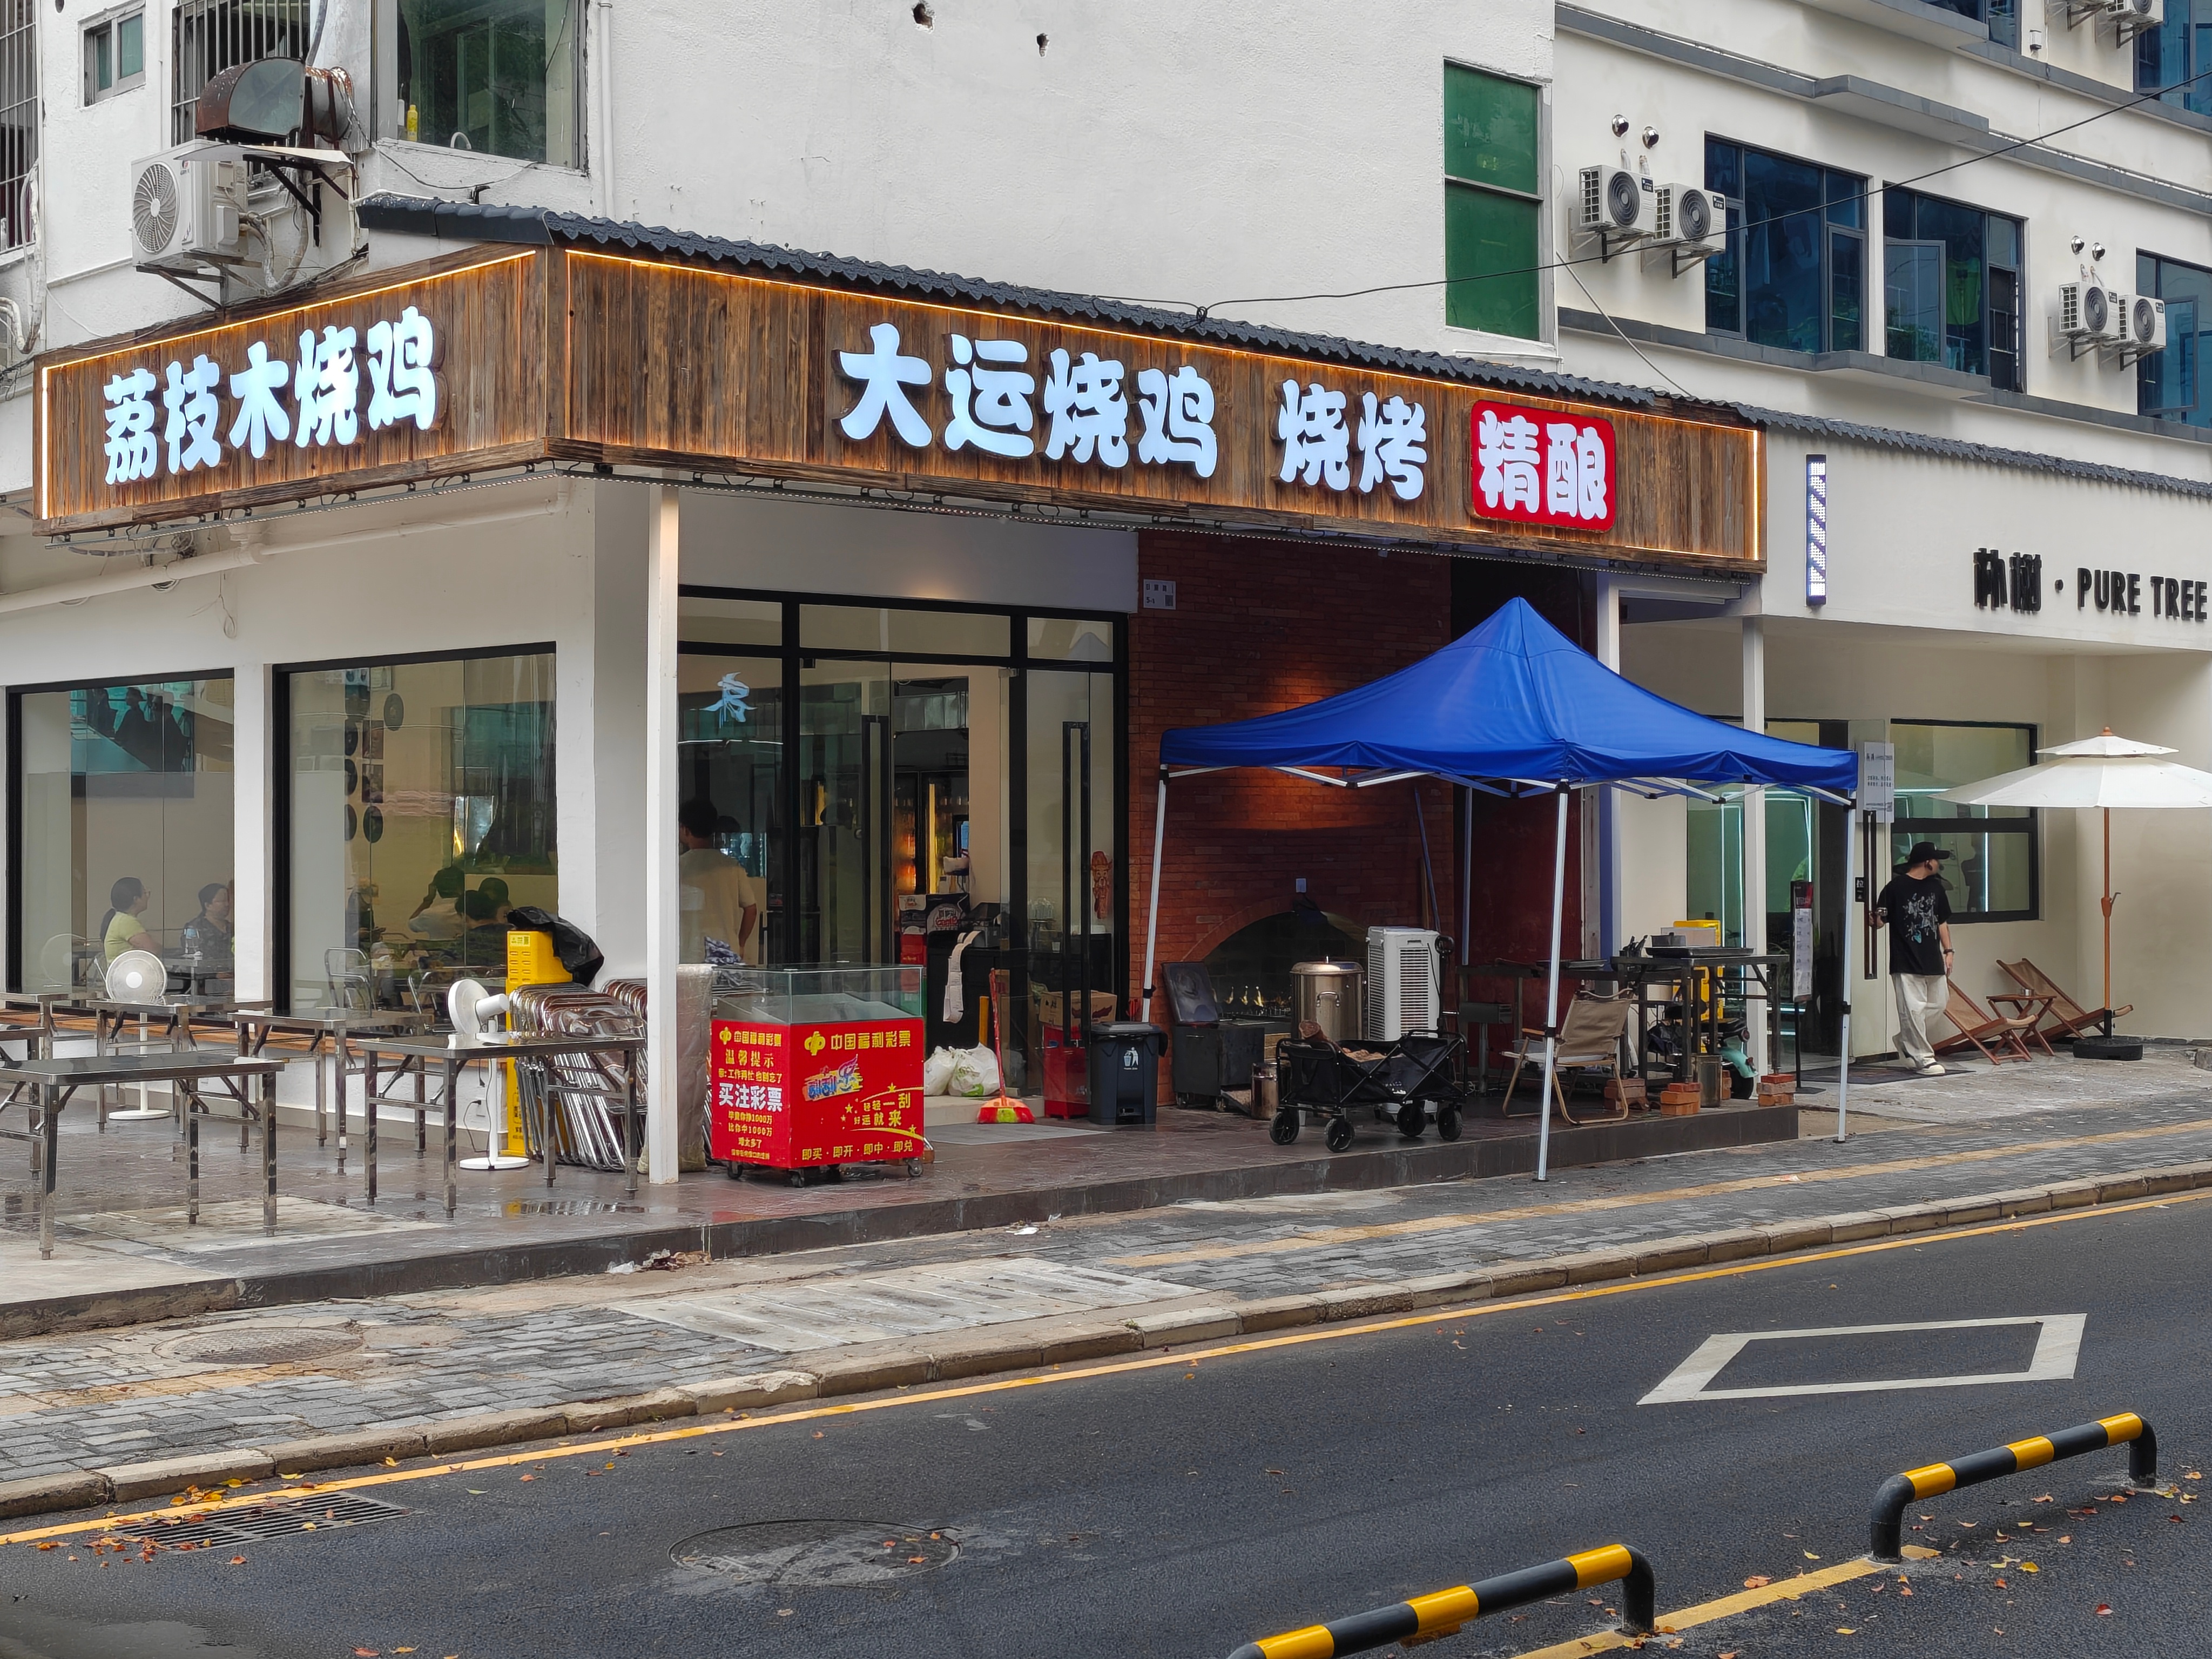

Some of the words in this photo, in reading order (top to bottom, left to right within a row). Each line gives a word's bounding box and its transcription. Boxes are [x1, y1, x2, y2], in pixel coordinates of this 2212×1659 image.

[104, 305, 436, 485] 荔枝木烧鸡
[838, 322, 1218, 478] 大运烧鸡
[1278, 378, 1427, 501] 烧烤
[1478, 409, 1607, 521] 精酿
[2077, 567, 2141, 613] PURE
[2149, 575, 2208, 621] TREE
[830, 1030, 911, 1050] 中国福利彩票
[718, 1082, 783, 1112] 买注彩票
[853, 1109, 902, 1127] 好运就来
[864, 1092, 911, 1112] 轻轻一刮
